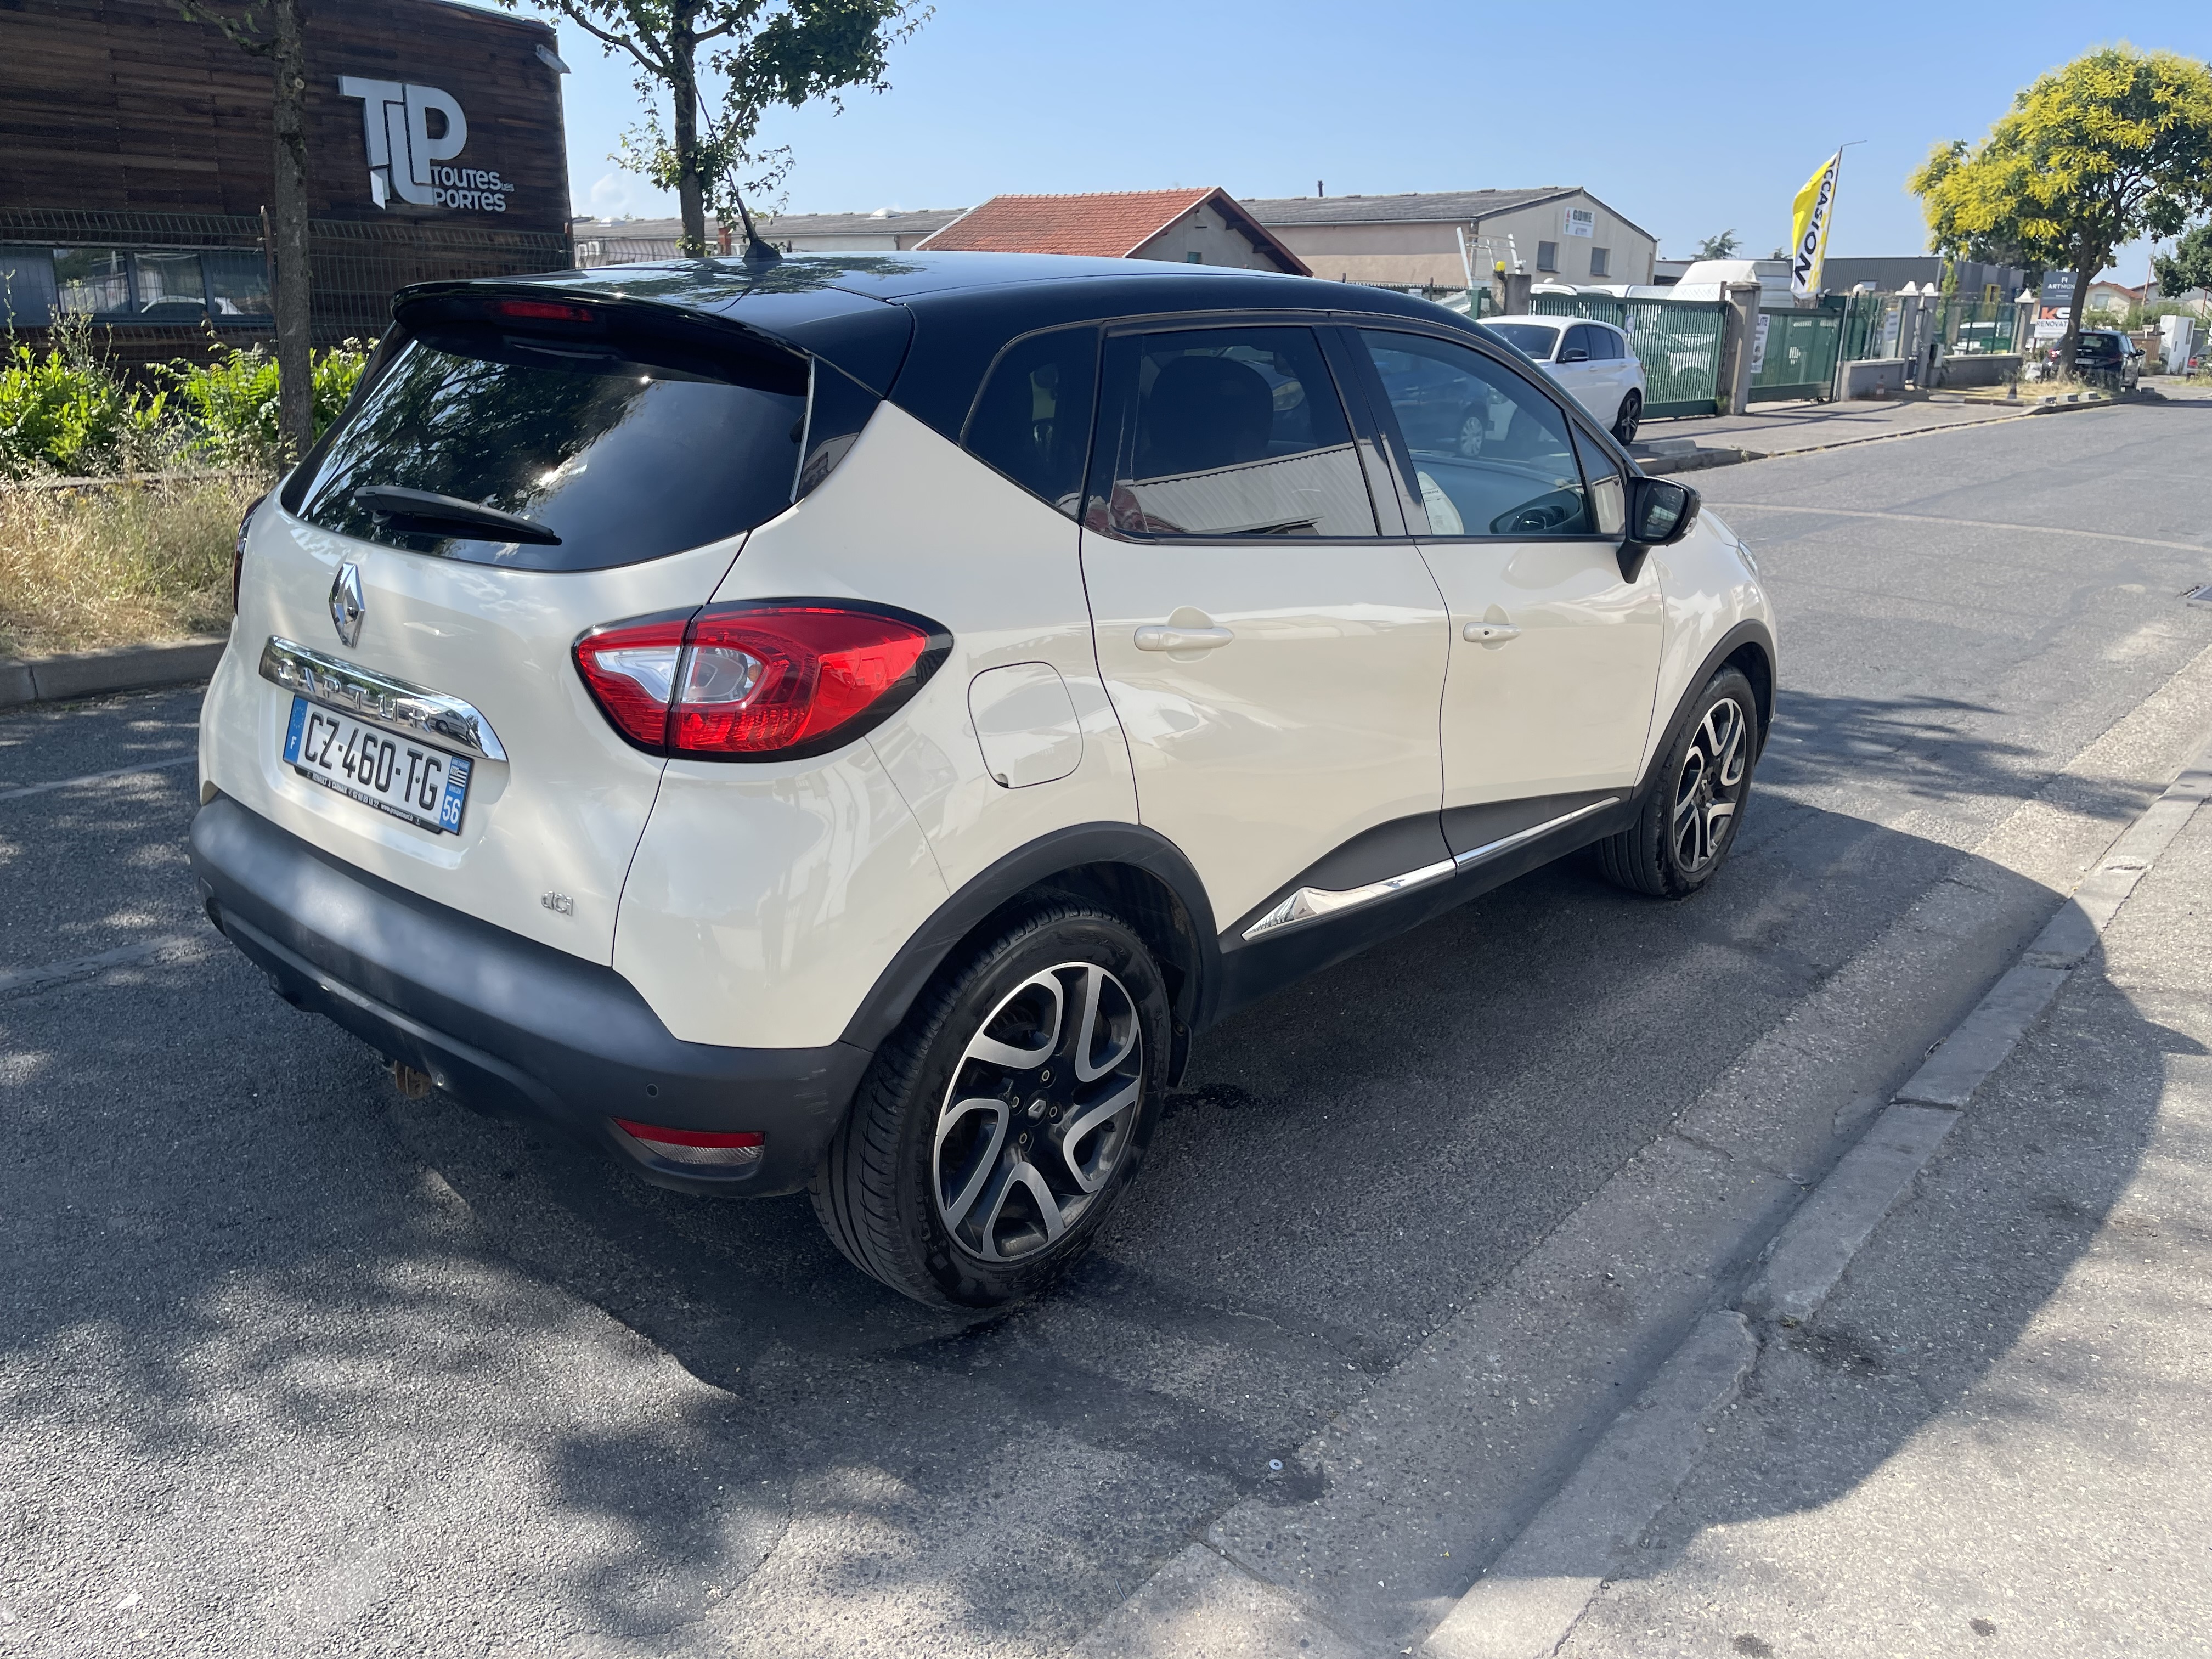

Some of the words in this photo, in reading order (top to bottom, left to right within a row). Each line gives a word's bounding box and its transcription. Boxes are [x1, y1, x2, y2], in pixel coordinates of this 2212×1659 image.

[290, 736, 297, 749] F
[304, 711, 442, 811] CZ-460-TG
[442, 795, 460, 824] 56
